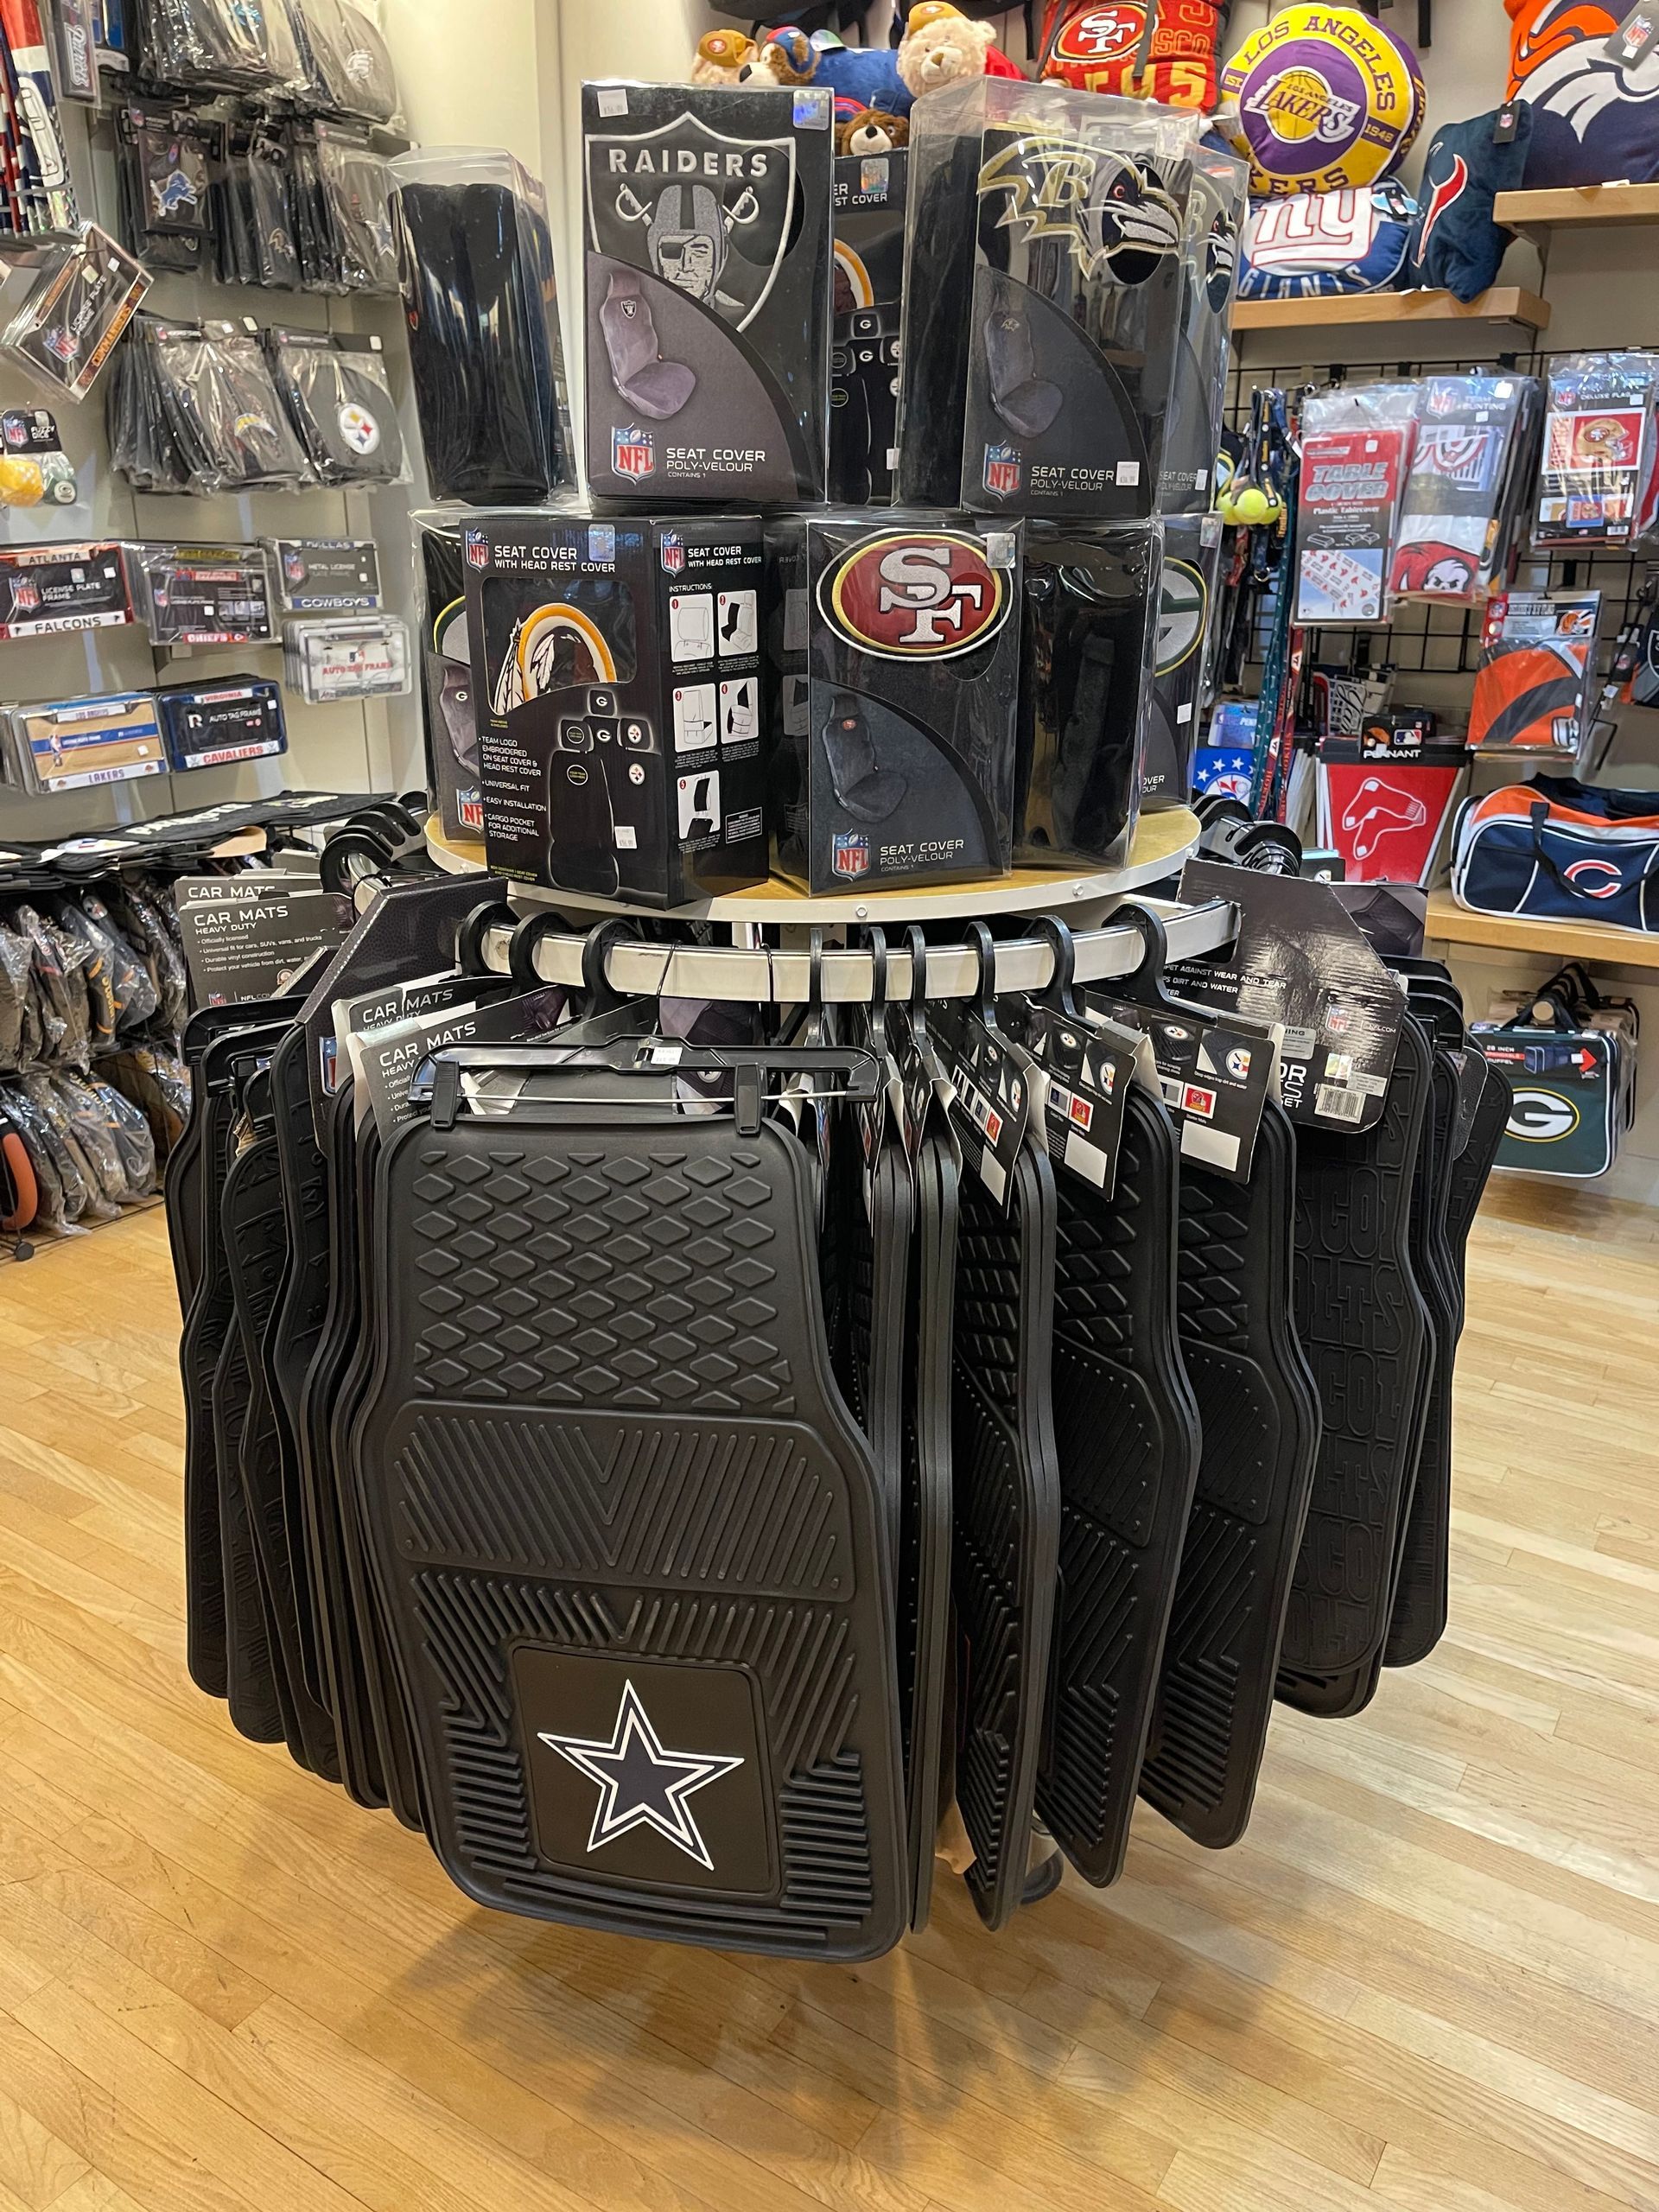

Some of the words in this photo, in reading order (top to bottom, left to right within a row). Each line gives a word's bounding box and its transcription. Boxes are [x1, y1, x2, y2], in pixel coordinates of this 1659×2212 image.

[1243, 21, 1290, 66] LOS
[1303, 16, 1395, 111] ANGELES
[1254, 79, 1350, 138] LAKERS
[1303, 90, 1353, 113] ANGELES
[609, 149, 768, 178] RAIDERS
[852, 193, 888, 206] COVER
[1239, 264, 1372, 299] GIANTS
[1559, 393, 1575, 404] NFL
[1580, 391, 1611, 400] DELUXE
[1432, 396, 1456, 410] NFL
[618, 445, 653, 474] NFL
[666, 448, 706, 460] SEAT
[713, 449, 766, 462] COVER
[666, 461, 753, 472] POLY-VELOUR
[1032, 466, 1065, 478] SEAT
[1071, 467, 1115, 481] COVER
[1313, 461, 1389, 484] TABLE
[988, 462, 1020, 491] NFL
[1031, 478, 1103, 492] POLY-VELOUR
[1305, 481, 1389, 502] COVER
[29, 553, 81, 564] ATLANTA
[469, 543, 489, 565] NFL
[495, 546, 526, 557] SEAT
[532, 547, 577, 560] COVER
[664, 547, 684, 569] NFL
[688, 547, 710, 557] SEAT
[713, 546, 741, 556] COVER
[495, 559, 517, 569] WITH
[521, 560, 548, 570] HEAD
[551, 562, 576, 571] REST
[582, 562, 615, 573] COVER
[41, 585, 74, 595] LICENSE
[76, 582, 101, 592] PLATE
[879, 546, 982, 643] SF
[16, 588, 40, 606] NFL
[42, 593, 71, 602] FRAME
[301, 598, 370, 607] COWBOYS
[35, 616, 102, 634] FALCONS
[204, 692, 243, 702] VIRGINIA
[240, 709, 262, 718] FRAME
[481, 736, 499, 745] TEAM
[203, 747, 264, 764] CAVALIERS
[482, 746, 528, 757] EMBROIDERED
[510, 758, 531, 766] COVER
[88, 769, 125, 784] LAKERS
[518, 766, 541, 776] COVER
[485, 779, 519, 791] UNIVERSAL
[503, 799, 547, 812] INSTALLATION
[487, 813, 509, 823] CARGO
[510, 817, 535, 827] POCKET
[489, 830, 518, 842] STORAGE
[502, 824, 539, 836] ADDITIONAL
[880, 842, 915, 855] SEAT
[920, 839, 964, 852] COVER
[837, 849, 868, 871] NFL
[880, 851, 953, 864] POLY-VELOUR
[188, 887, 222, 898] CAR
[194, 912, 231, 926] CAR
[239, 906, 289, 922] MATS
[195, 925, 226, 935] HEAVY
[231, 922, 257, 931] DUTY
[201, 936, 226, 944] Officially
[226, 934, 249, 943] licensed
[203, 944, 229, 954] Universal
[259, 939, 276, 948] SUVs,
[305, 934, 322, 943] trucks
[205, 954, 227, 963] Durable
[241, 950, 275, 960] construction
[207, 964, 227, 973] Protect
[241, 960, 260, 969] vehicle
[1180, 965, 1212, 976] AGAINST
[1214, 970, 1237, 981] WEAR
[1240, 974, 1261, 985] AND
[1262, 978, 1287, 989] TEAR
[1173, 976, 1189, 985] DIRT
[1191, 980, 1208, 988] AND
[1211, 982, 1238, 995] WATER
[362, 1001, 397, 1023] CAR
[406, 988, 454, 1009] MATS
[1330, 1018, 1347, 1031] NFL
[379, 1042, 419, 1067] CAR
[426, 1021, 476, 1050] MATS
[381, 1059, 415, 1078] HEAVY
